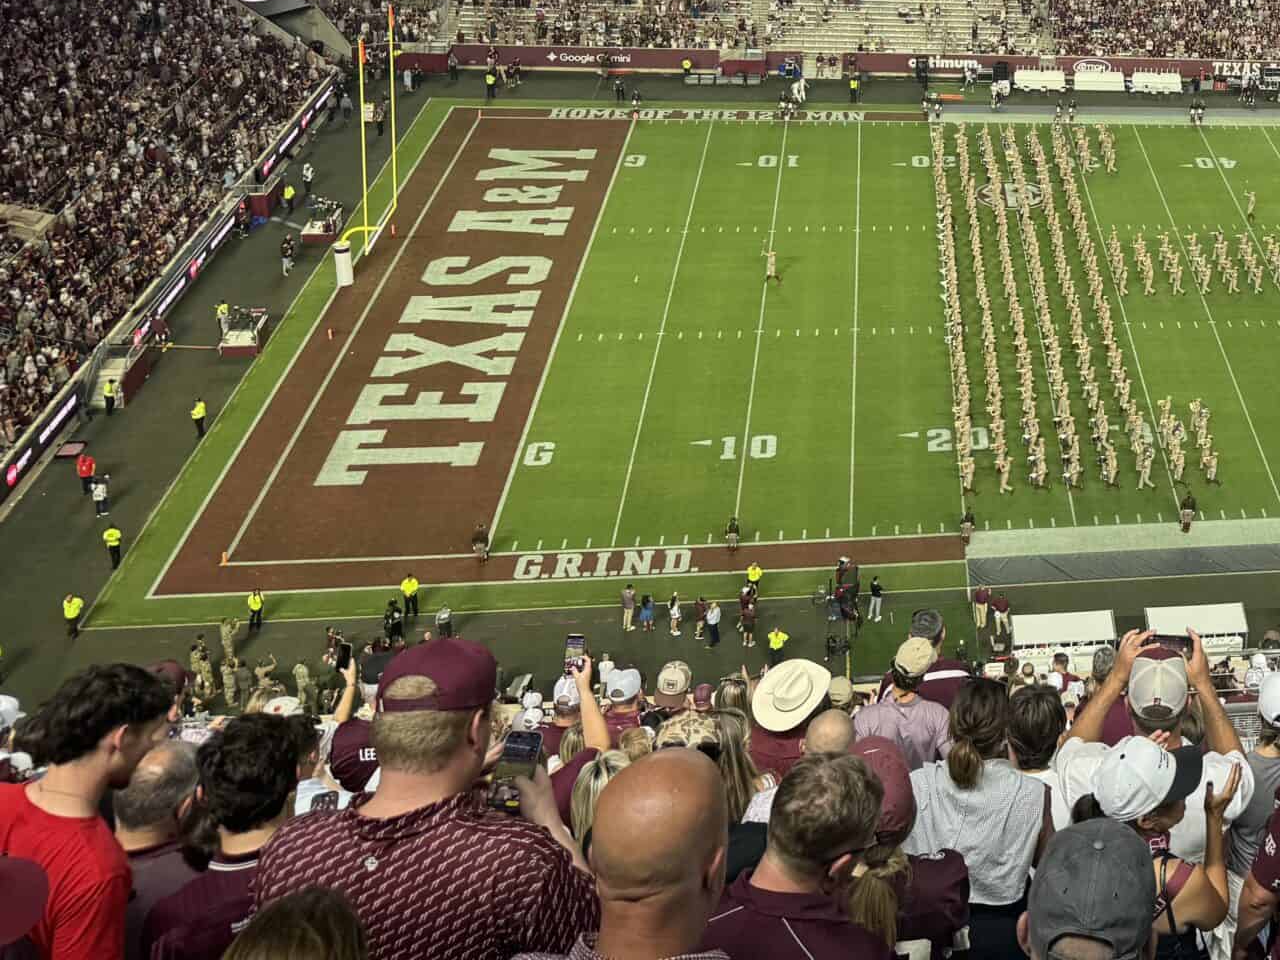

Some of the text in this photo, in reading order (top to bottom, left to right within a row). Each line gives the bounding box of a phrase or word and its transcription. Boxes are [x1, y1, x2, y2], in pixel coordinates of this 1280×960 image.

[559, 53, 631, 65] Google Gmini
[909, 55, 982, 70] otimum.
[1212, 62, 1261, 76] TEXAS
[549, 108, 628, 121] HOME
[637, 109, 673, 121] OF
[685, 109, 738, 121] THE
[806, 110, 864, 123] MAN
[1194, 156, 1238, 170] 40
[447, 147, 598, 237] A&M
[313, 255, 554, 487] TEXAS
[523, 441, 557, 467] G
[720, 434, 777, 461] 10
[513, 548, 700, 581] G.R.I.N.D.
